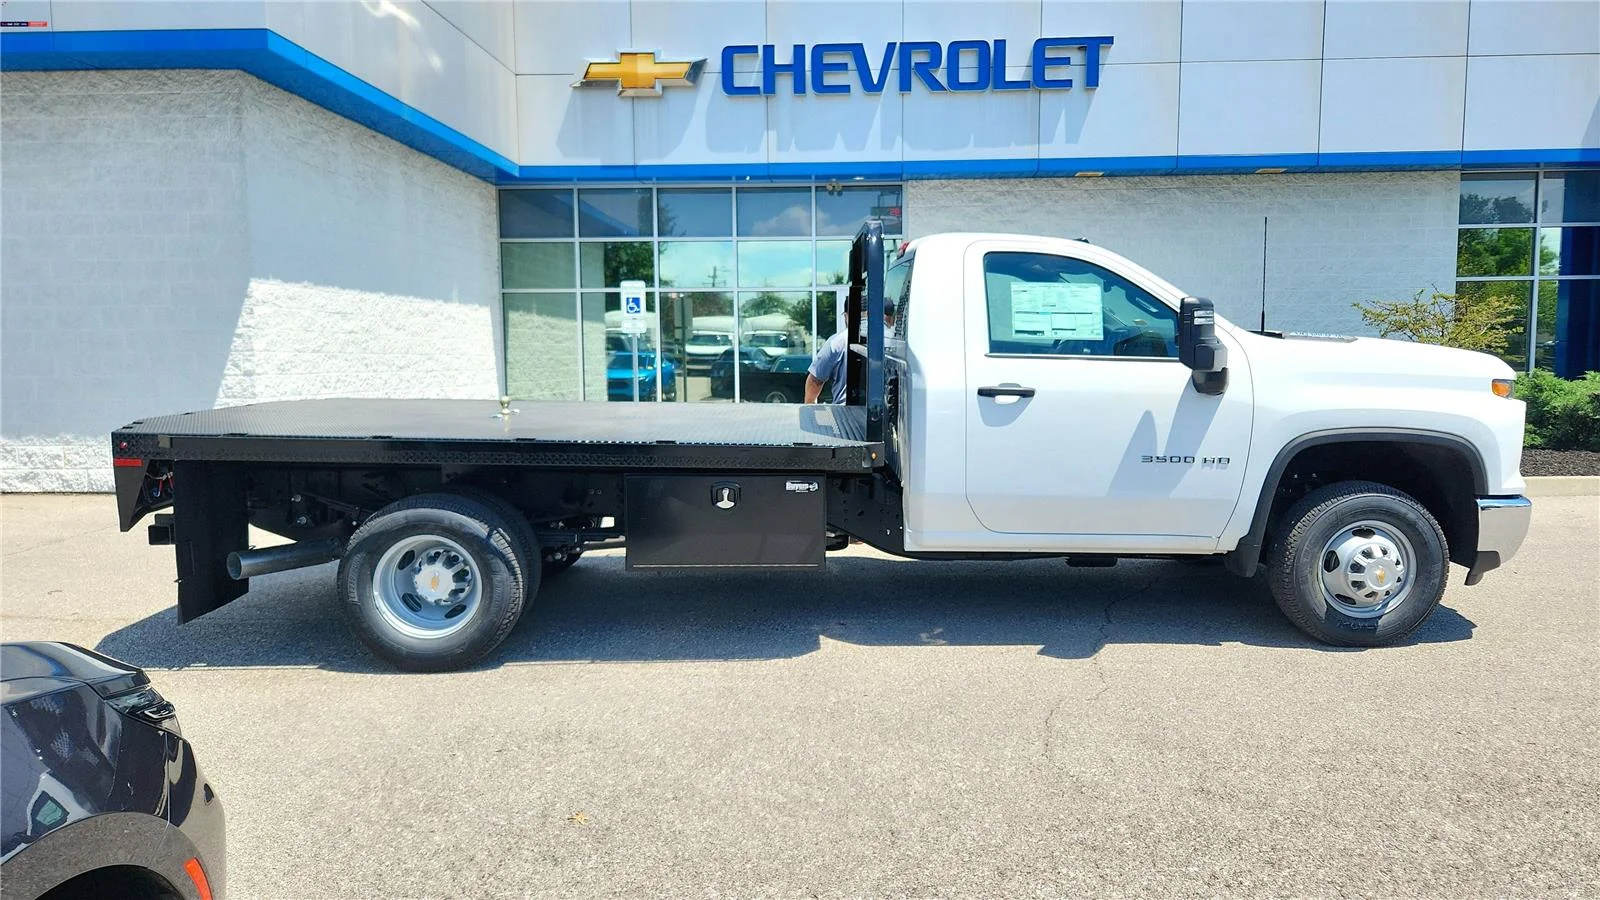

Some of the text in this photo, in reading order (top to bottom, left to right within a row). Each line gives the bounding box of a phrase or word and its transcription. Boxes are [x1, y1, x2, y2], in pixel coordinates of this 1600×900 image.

[721, 36, 1114, 96] CHEVROLET
[1141, 455, 1231, 465] 3500 HD
